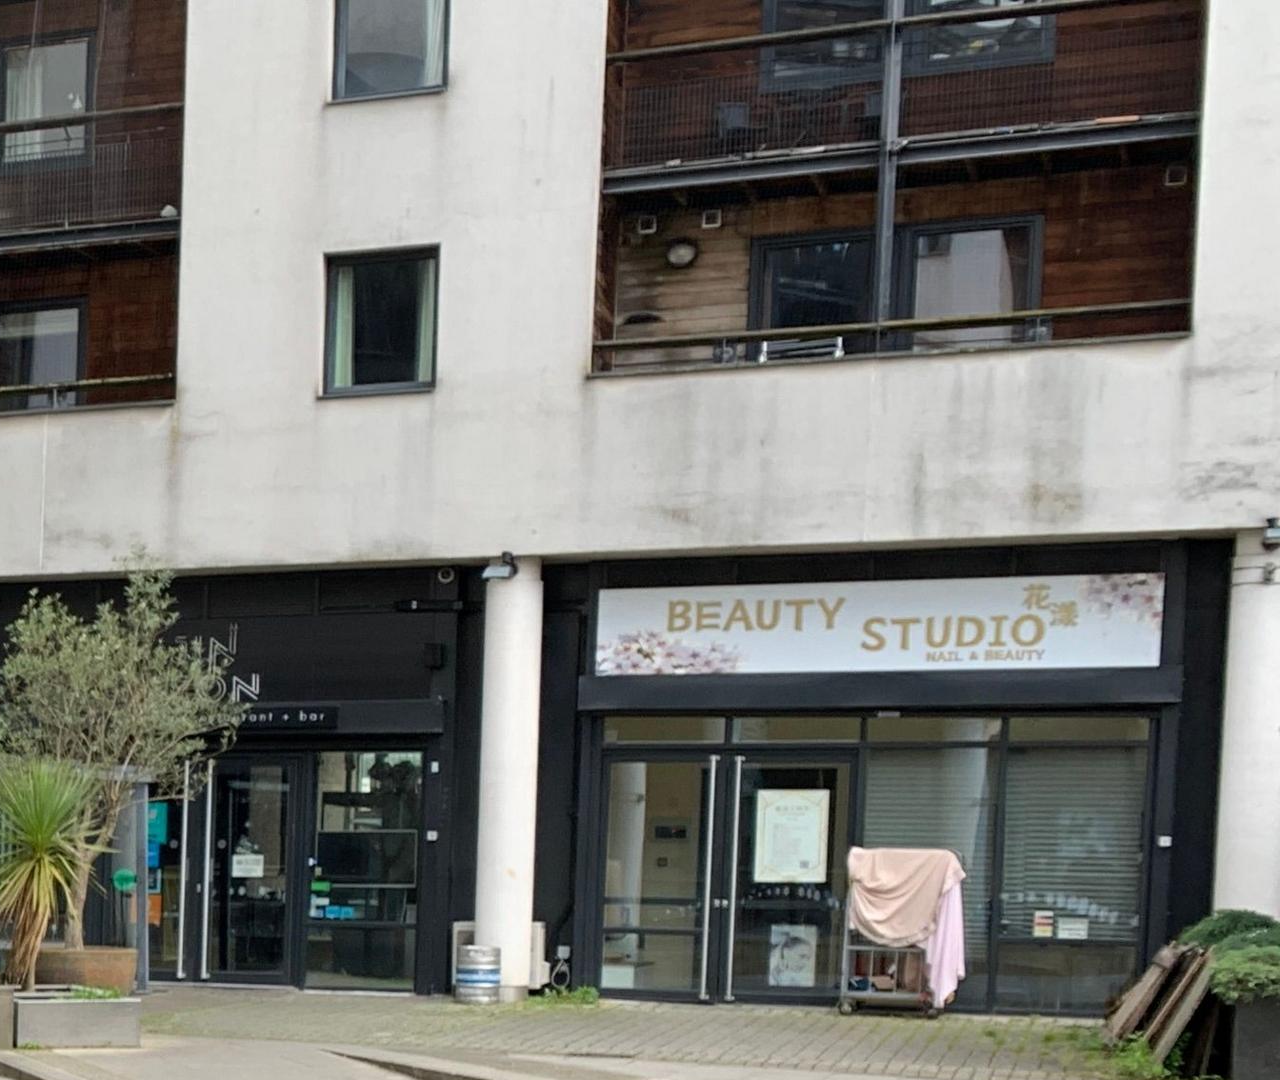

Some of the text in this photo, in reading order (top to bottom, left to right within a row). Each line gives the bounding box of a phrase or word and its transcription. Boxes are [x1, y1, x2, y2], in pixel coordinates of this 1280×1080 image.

[666, 598, 1046, 652] BEAUTY STUDIO
[925, 651, 963, 662] NAIL
[984, 649, 1046, 661] BEAUTY
[298, 710, 325, 722] bar
